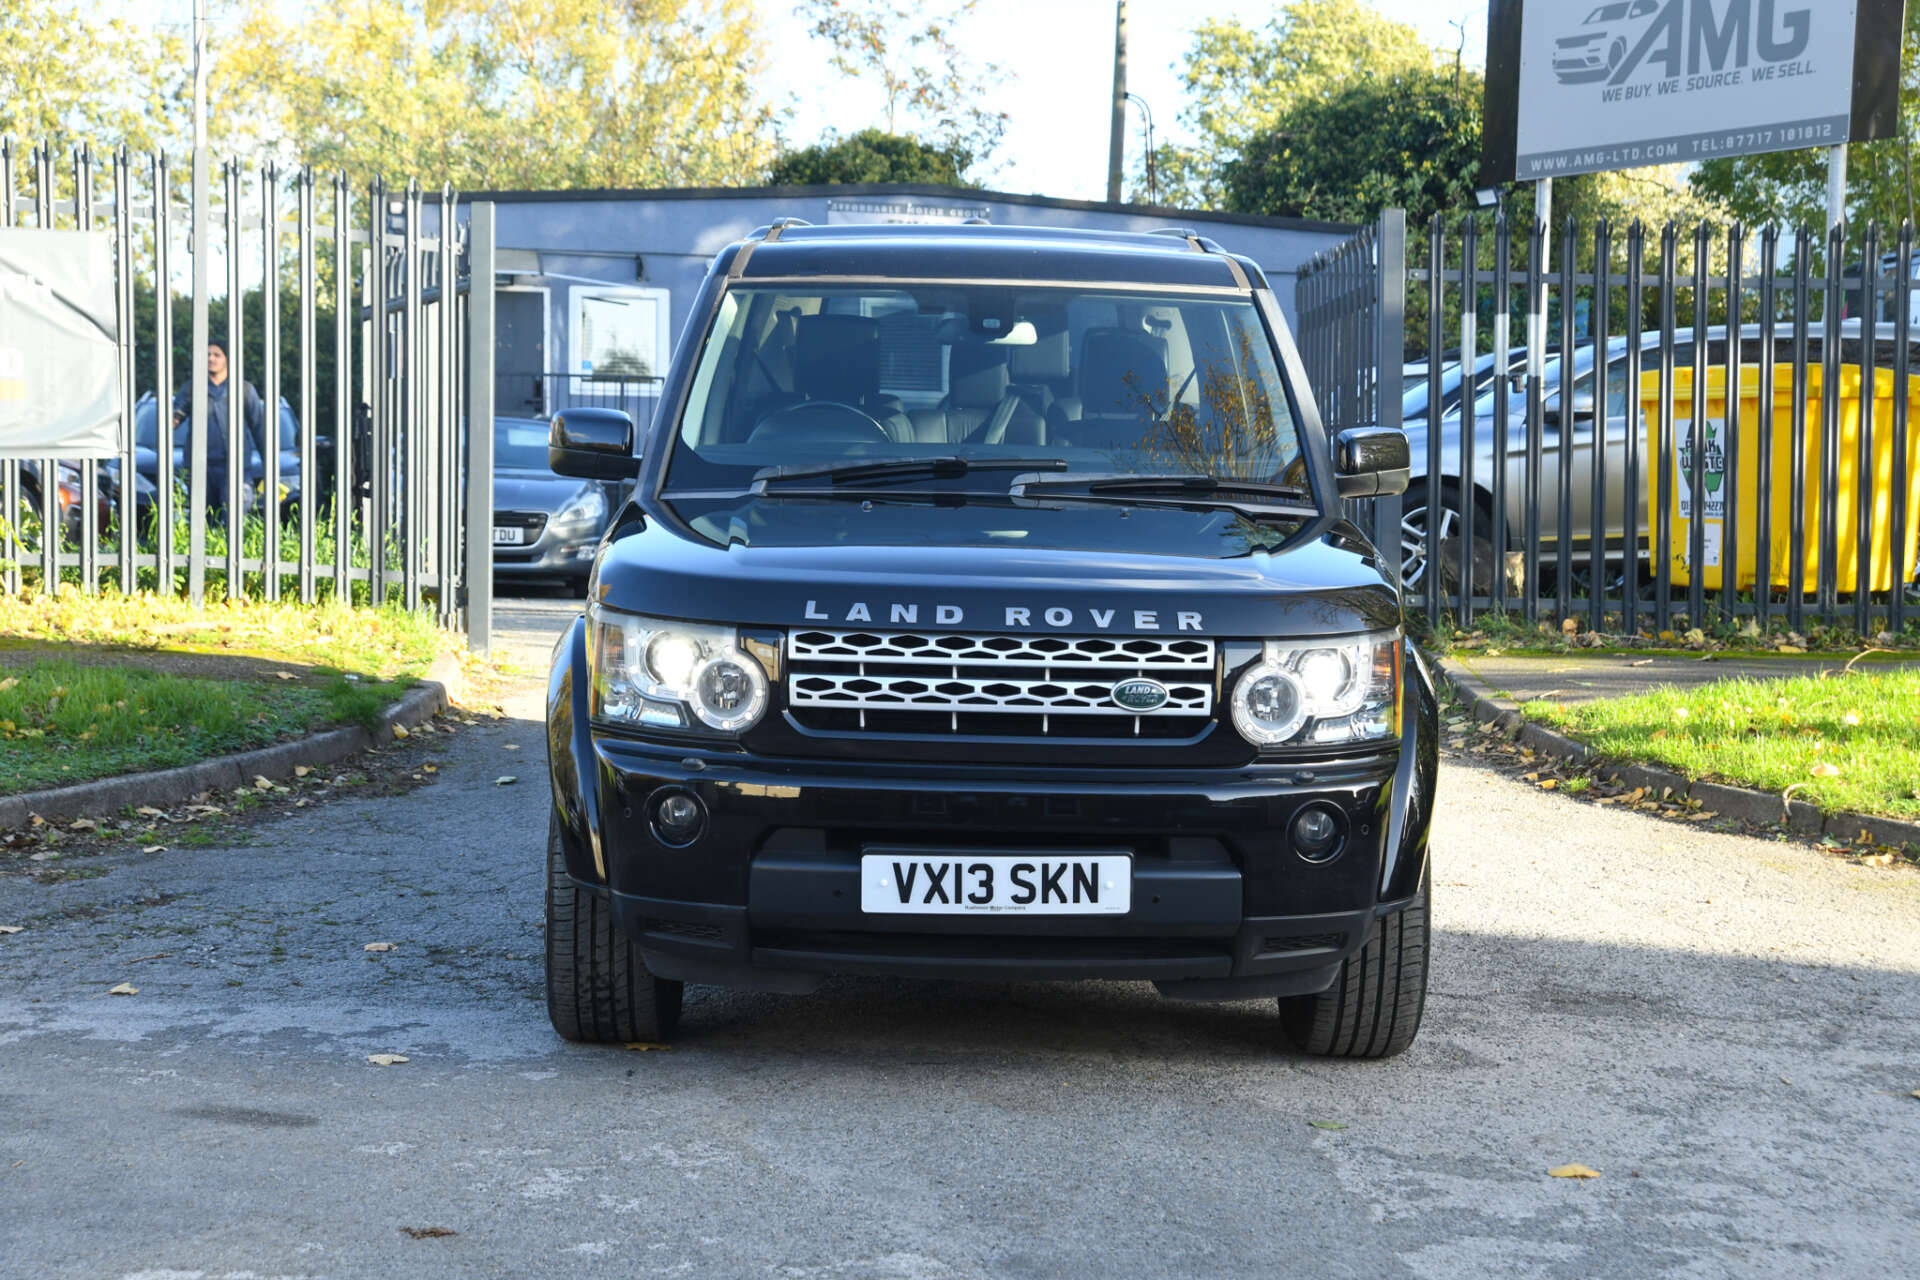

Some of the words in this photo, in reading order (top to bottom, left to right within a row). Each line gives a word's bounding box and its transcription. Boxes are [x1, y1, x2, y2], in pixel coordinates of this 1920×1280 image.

[1607, 0, 1811, 86] AMG
[1601, 86, 1622, 104] WE
[1751, 65, 1774, 82] WE
[1531, 142, 1679, 172] WWW.AMG-LTD.COM
[1685, 440, 1716, 453] PK
[804, 600, 964, 625] LAND
[1005, 606, 1203, 631] ROVER
[1125, 685, 1151, 695] LAND
[892, 862, 994, 904] VX13
[1010, 862, 1099, 904] SKN
